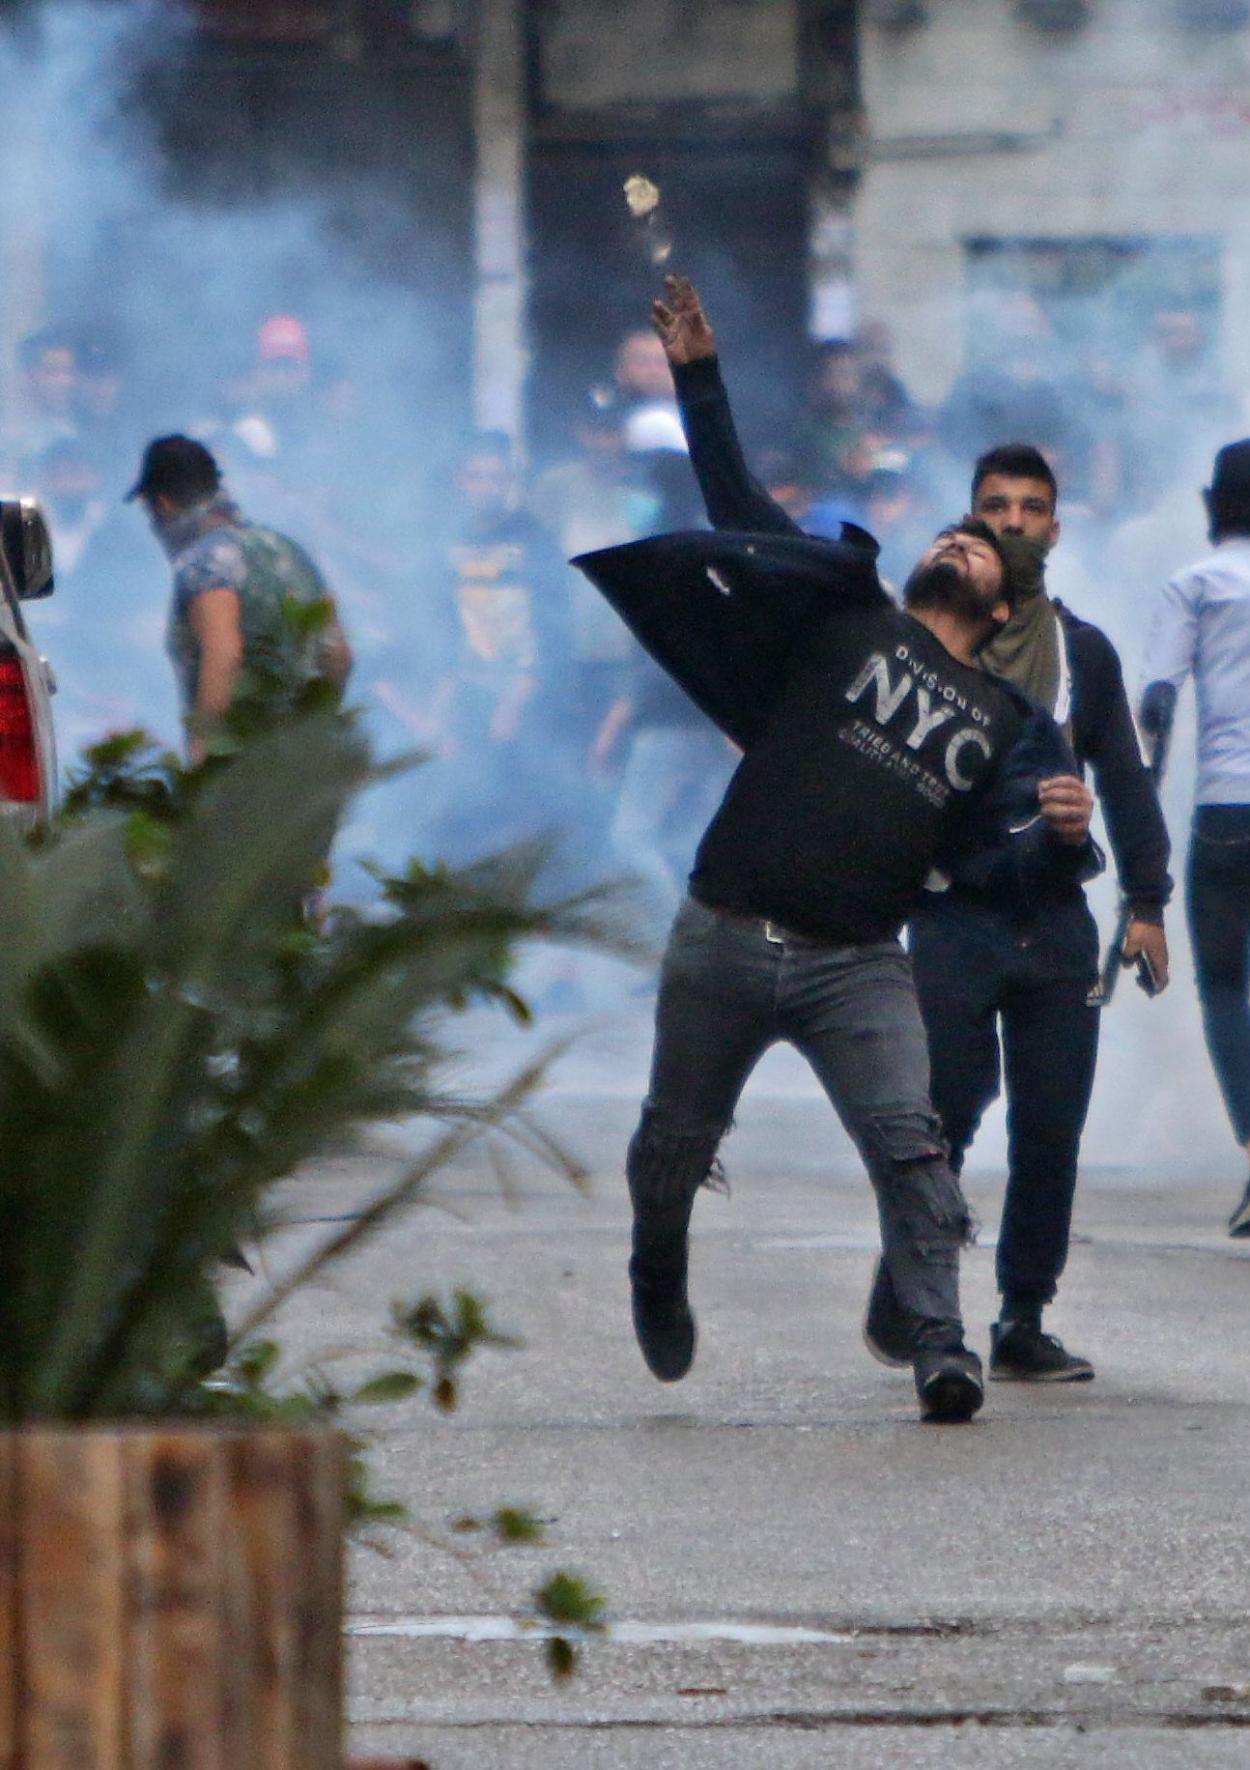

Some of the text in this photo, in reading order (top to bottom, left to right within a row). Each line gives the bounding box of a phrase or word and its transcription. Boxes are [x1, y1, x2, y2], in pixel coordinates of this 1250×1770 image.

[896, 645, 967, 710] DIVISION
[844, 652, 992, 792] NYC
[852, 720, 890, 754] TRIED
